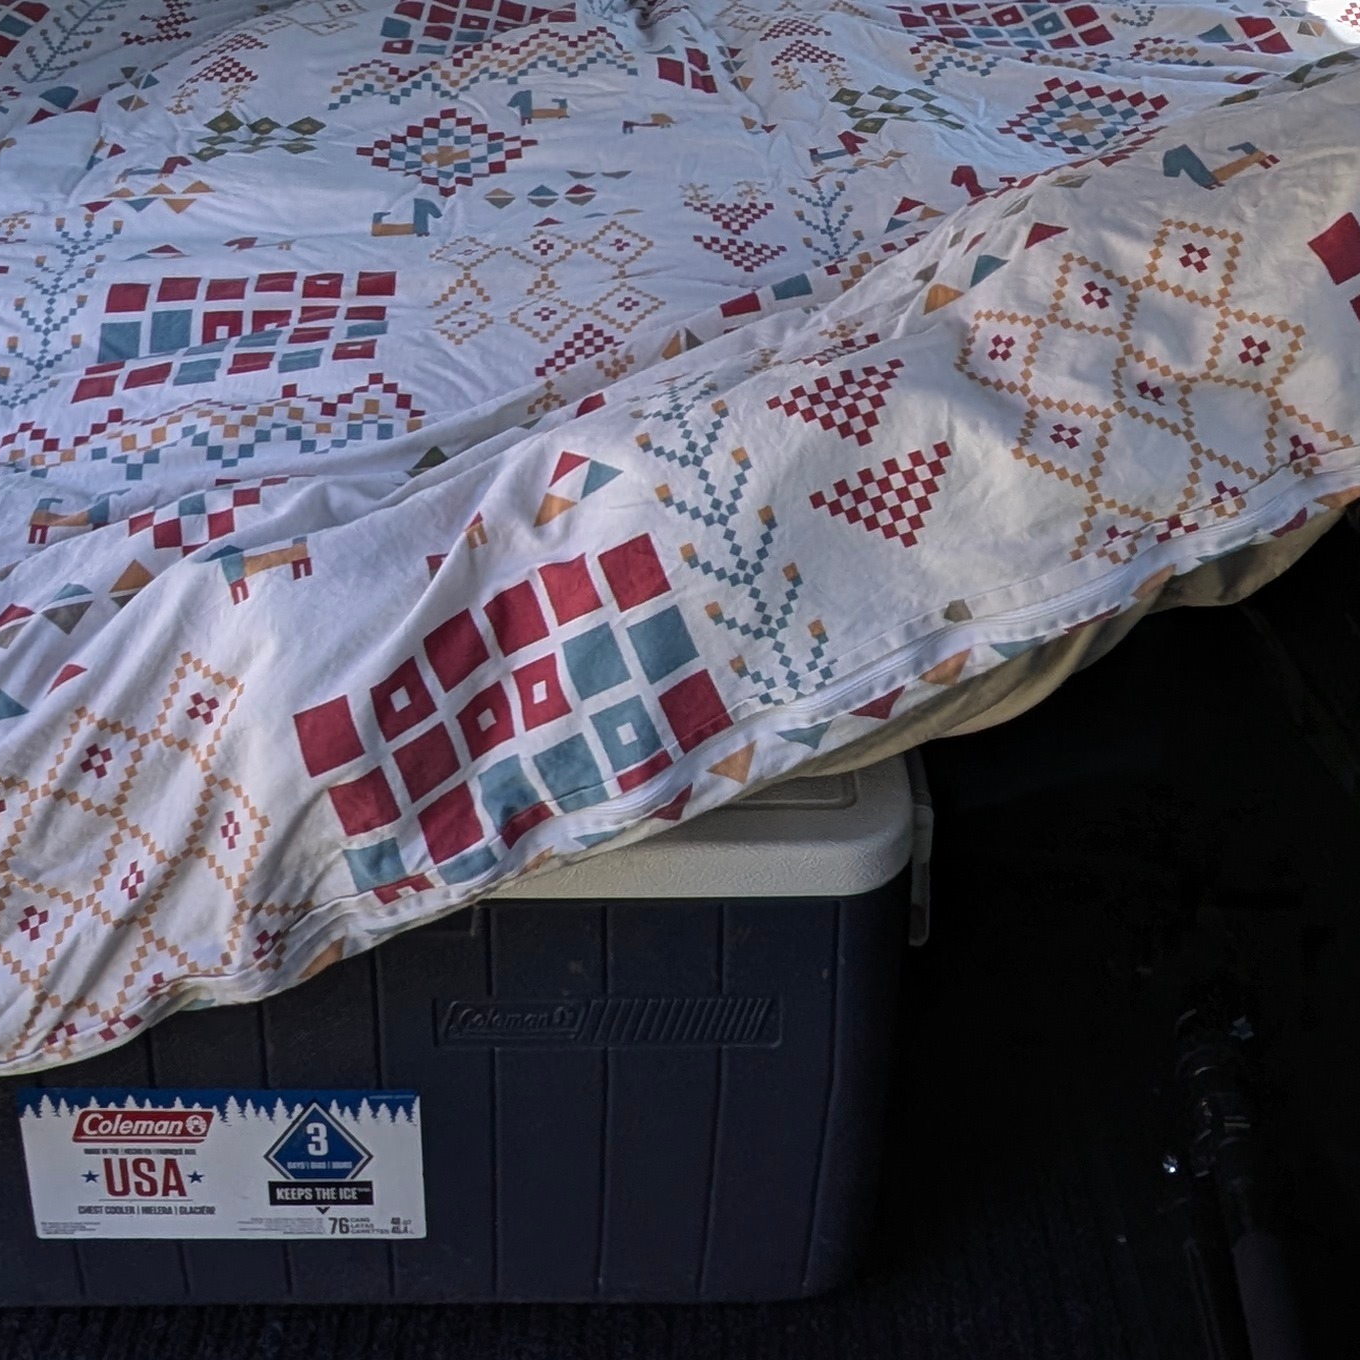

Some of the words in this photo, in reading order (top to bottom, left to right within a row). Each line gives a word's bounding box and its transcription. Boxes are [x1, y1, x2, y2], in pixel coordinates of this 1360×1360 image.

[458, 1007, 549, 1030] Coleman
[82, 1112, 184, 1135] Coleman
[306, 1122, 329, 1157] 3
[103, 1158, 187, 1197] USA
[275, 1187, 313, 1200] KEEPS
[314, 1187, 337, 1200] THE
[339, 1187, 358, 1200] ICE
[78, 1205, 104, 1215] CHEST
[105, 1205, 135, 1215] COOLER
[328, 1217, 350, 1235] 76
